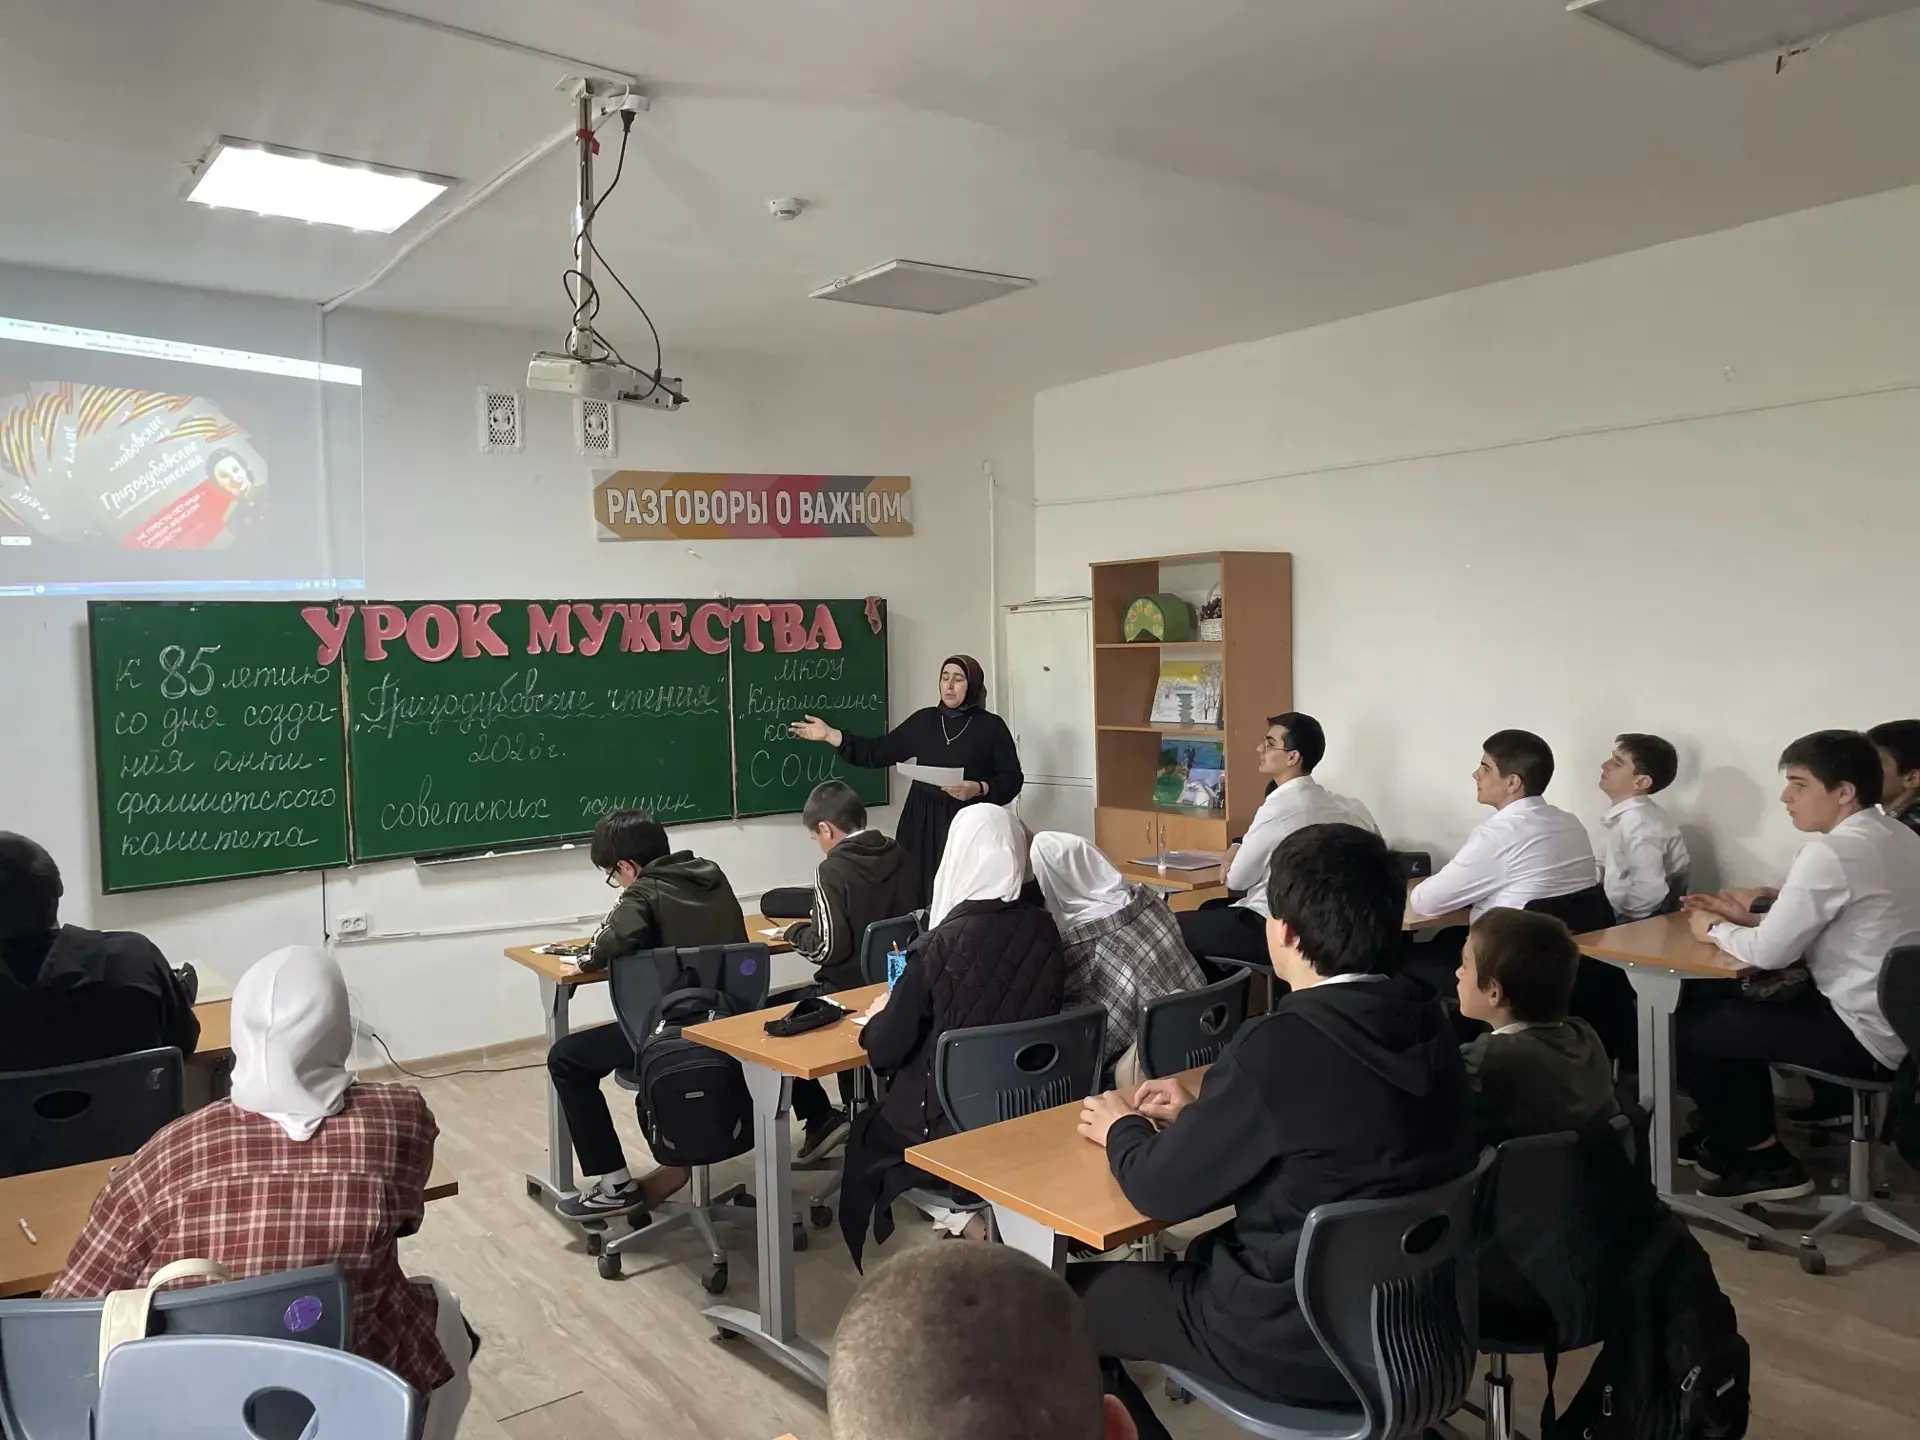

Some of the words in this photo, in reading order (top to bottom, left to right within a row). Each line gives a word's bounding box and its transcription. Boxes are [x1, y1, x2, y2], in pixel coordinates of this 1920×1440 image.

[606, 488, 768, 525] РАЗГОВОРЫ
[775, 490, 791, 525] О
[800, 491, 901, 525] ВАЖНОМ
[301, 604, 509, 666] УРОК
[526, 603, 843, 657] МУЖЕСТВА
[159, 644, 221, 700] 85
[222, 665, 330, 690] летию
[774, 656, 845, 682] МКОУ
[115, 711, 148, 735] со
[161, 705, 226, 748] дня
[244, 700, 338, 745] созда-
[120, 749, 196, 779] ния
[750, 749, 845, 788] СОШ
[116, 787, 336, 824] фашистского
[381, 774, 551, 830] советских
[121, 826, 319, 856] комитета
